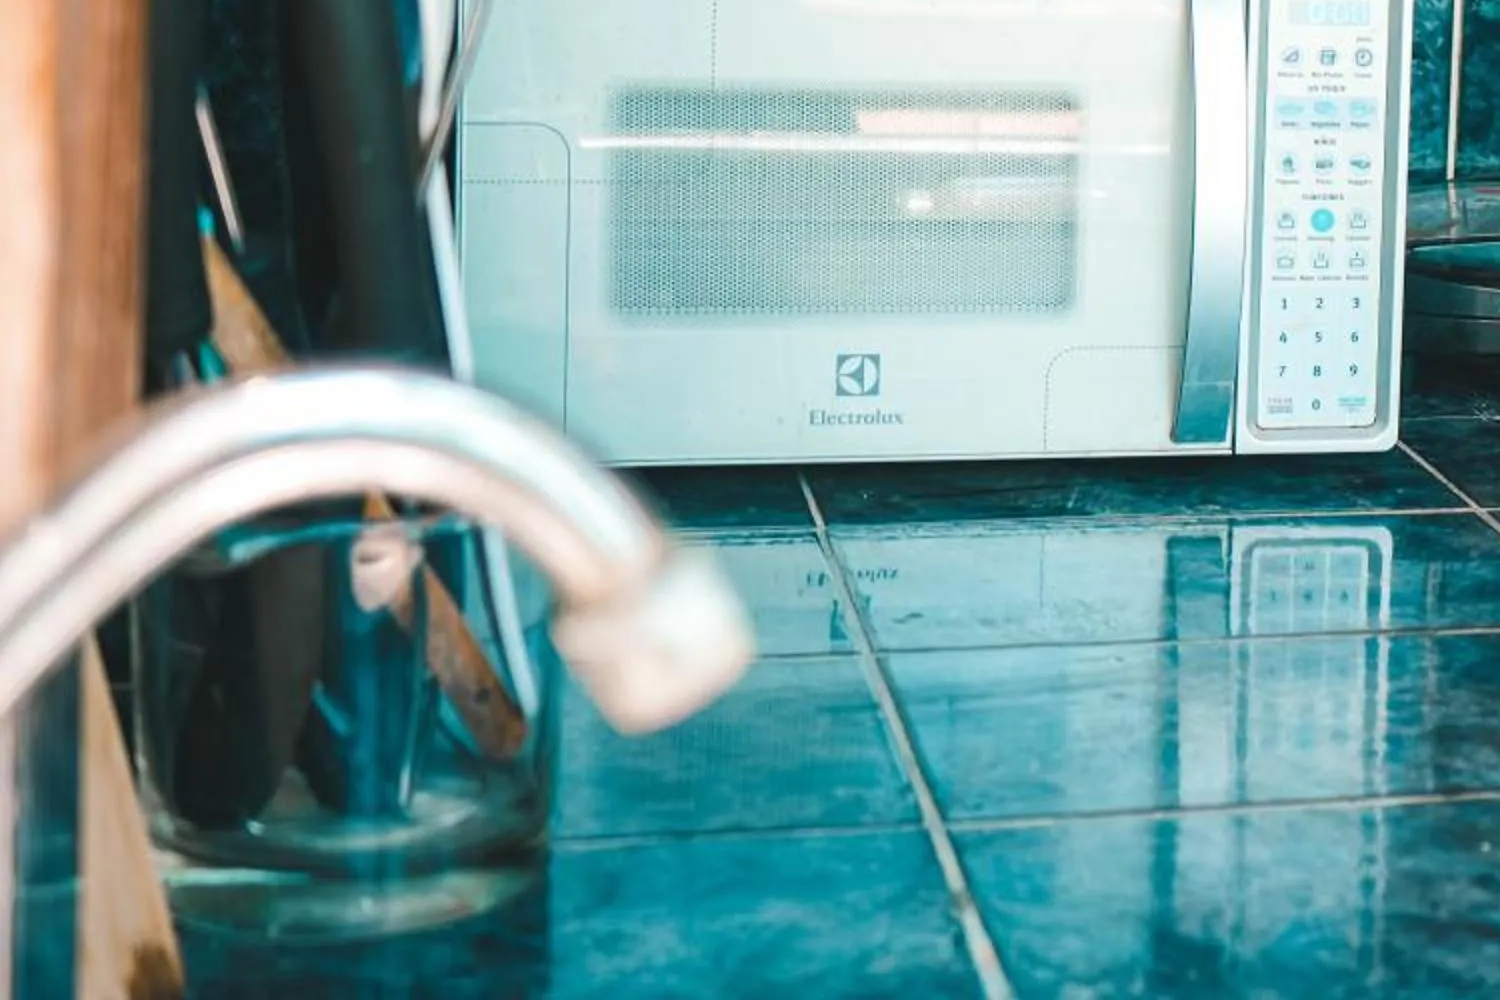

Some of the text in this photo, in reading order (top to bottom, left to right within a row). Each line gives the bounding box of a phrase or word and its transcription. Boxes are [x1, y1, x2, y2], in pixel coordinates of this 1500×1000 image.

[1281, 297, 1288, 310] 1
[1315, 297, 1324, 309] 2
[1351, 297, 1361, 309] 3
[1314, 331, 1323, 343] 5
[1350, 331, 1359, 343] 6
[1278, 365, 1287, 377] 7
[1312, 365, 1322, 377] 8
[1349, 363, 1359, 377] 9
[1311, 398, 1321, 411] 0
[808, 408, 905, 426] Electrolux
